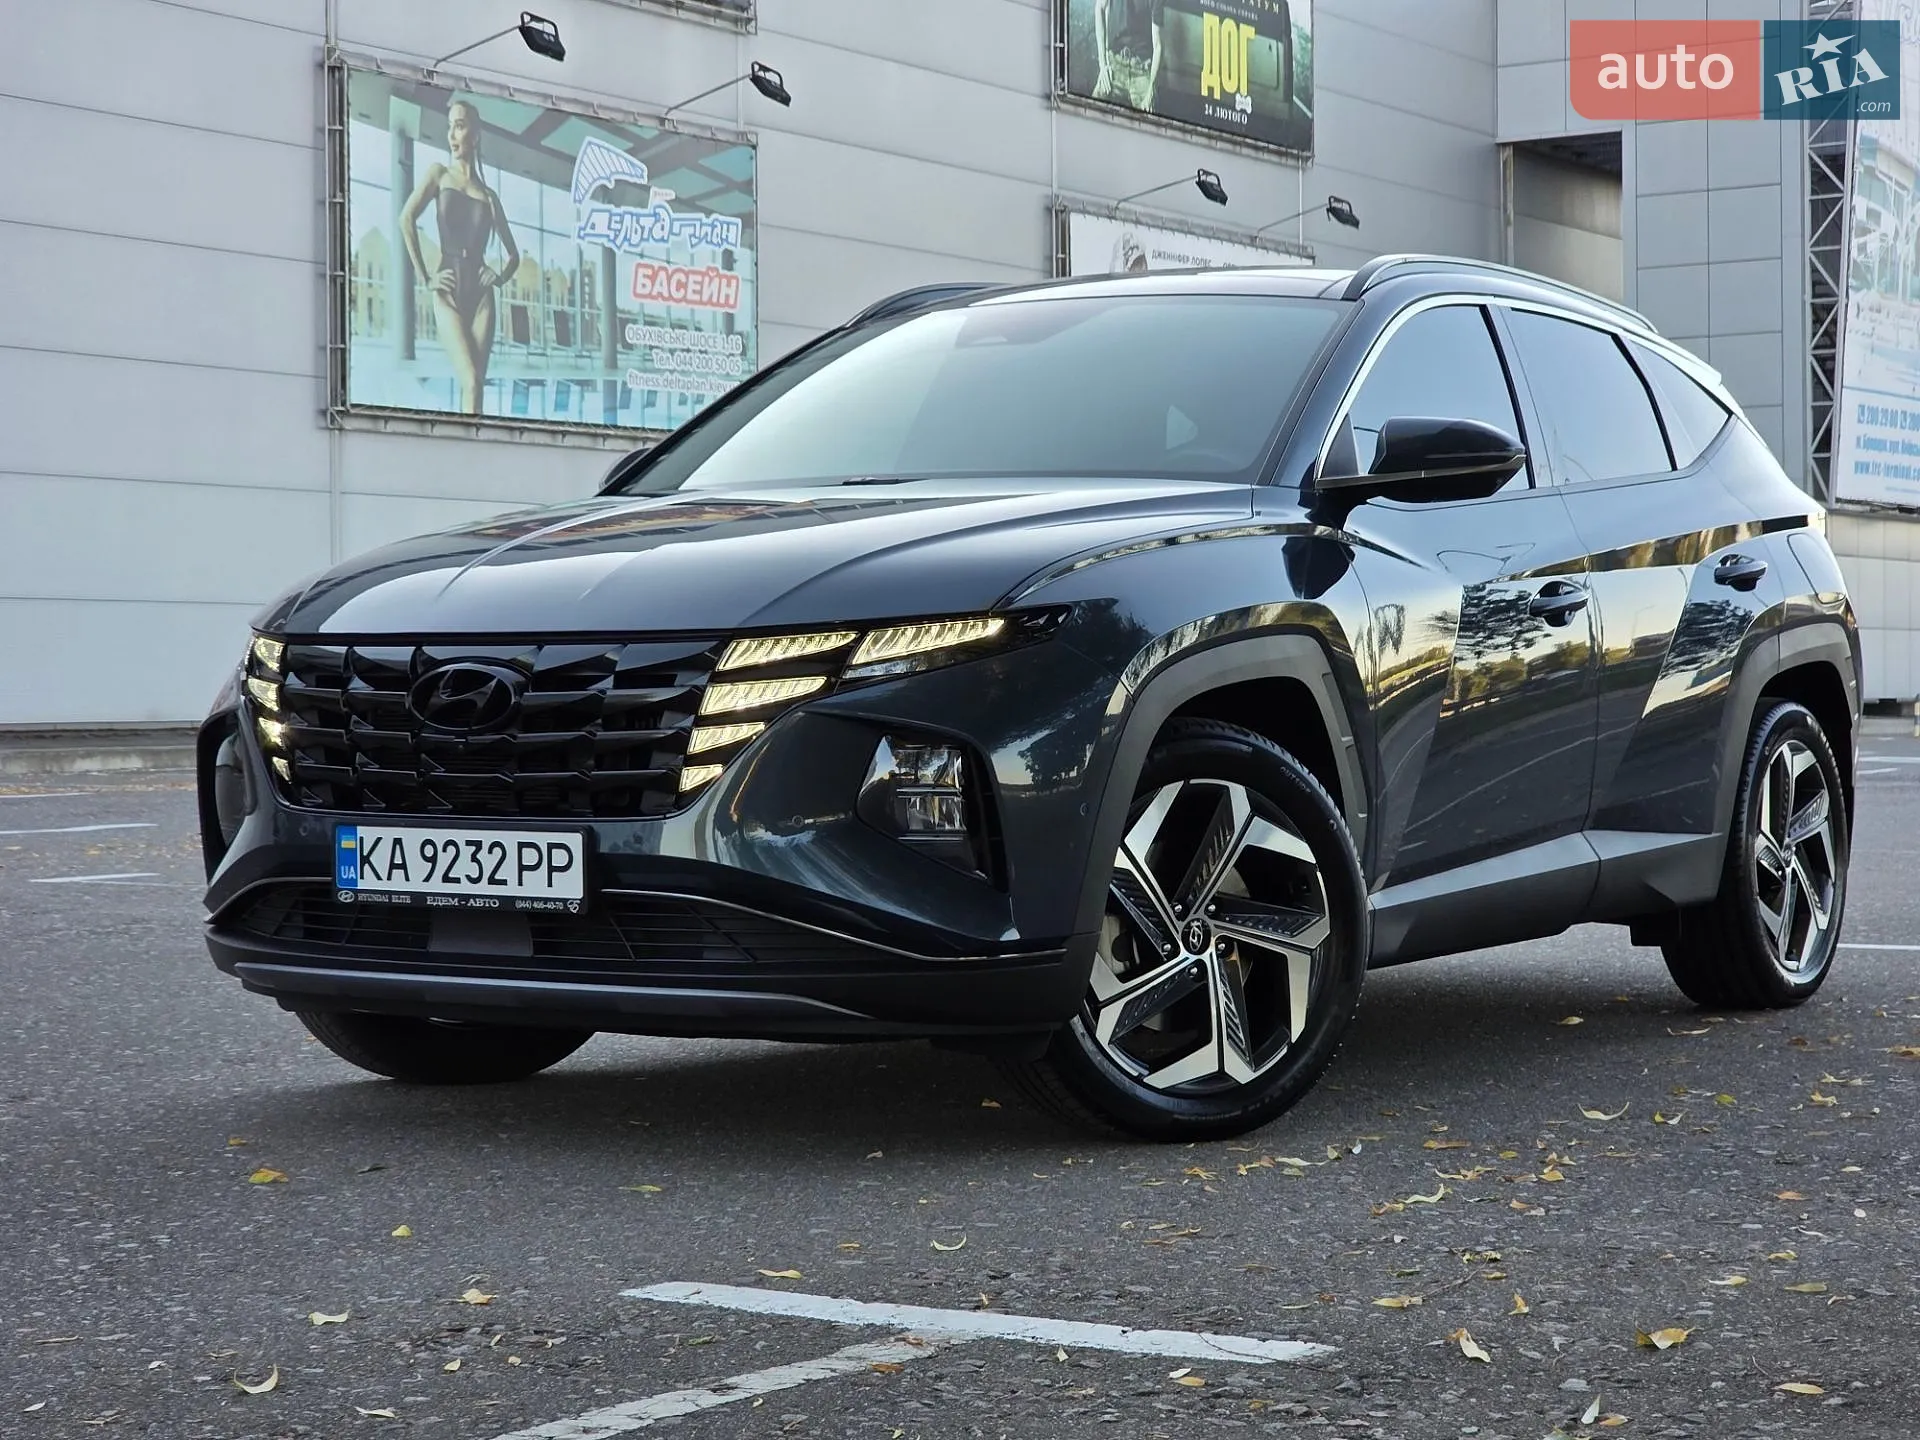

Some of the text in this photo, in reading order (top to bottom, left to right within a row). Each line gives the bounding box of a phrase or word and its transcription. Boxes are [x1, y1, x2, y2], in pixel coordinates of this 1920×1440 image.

[1201, 12, 1255, 100] ДОГ
[1214, 106, 1248, 124] ЛЮТОГО
[635, 266, 738, 308] БАСЕЙН
[627, 326, 686, 345] ОБУХІВСЬКЕ
[690, 333, 718, 349] ШОСЕ
[654, 351, 740, 373] Тел. 044 200 50 05
[340, 865, 356, 880] UA
[359, 836, 574, 888] KA 9232 PP
[357, 893, 411, 904] HYUNDAI ELITE
[426, 896, 459, 906] ЕДЕМ
[467, 898, 500, 908] АВТО
